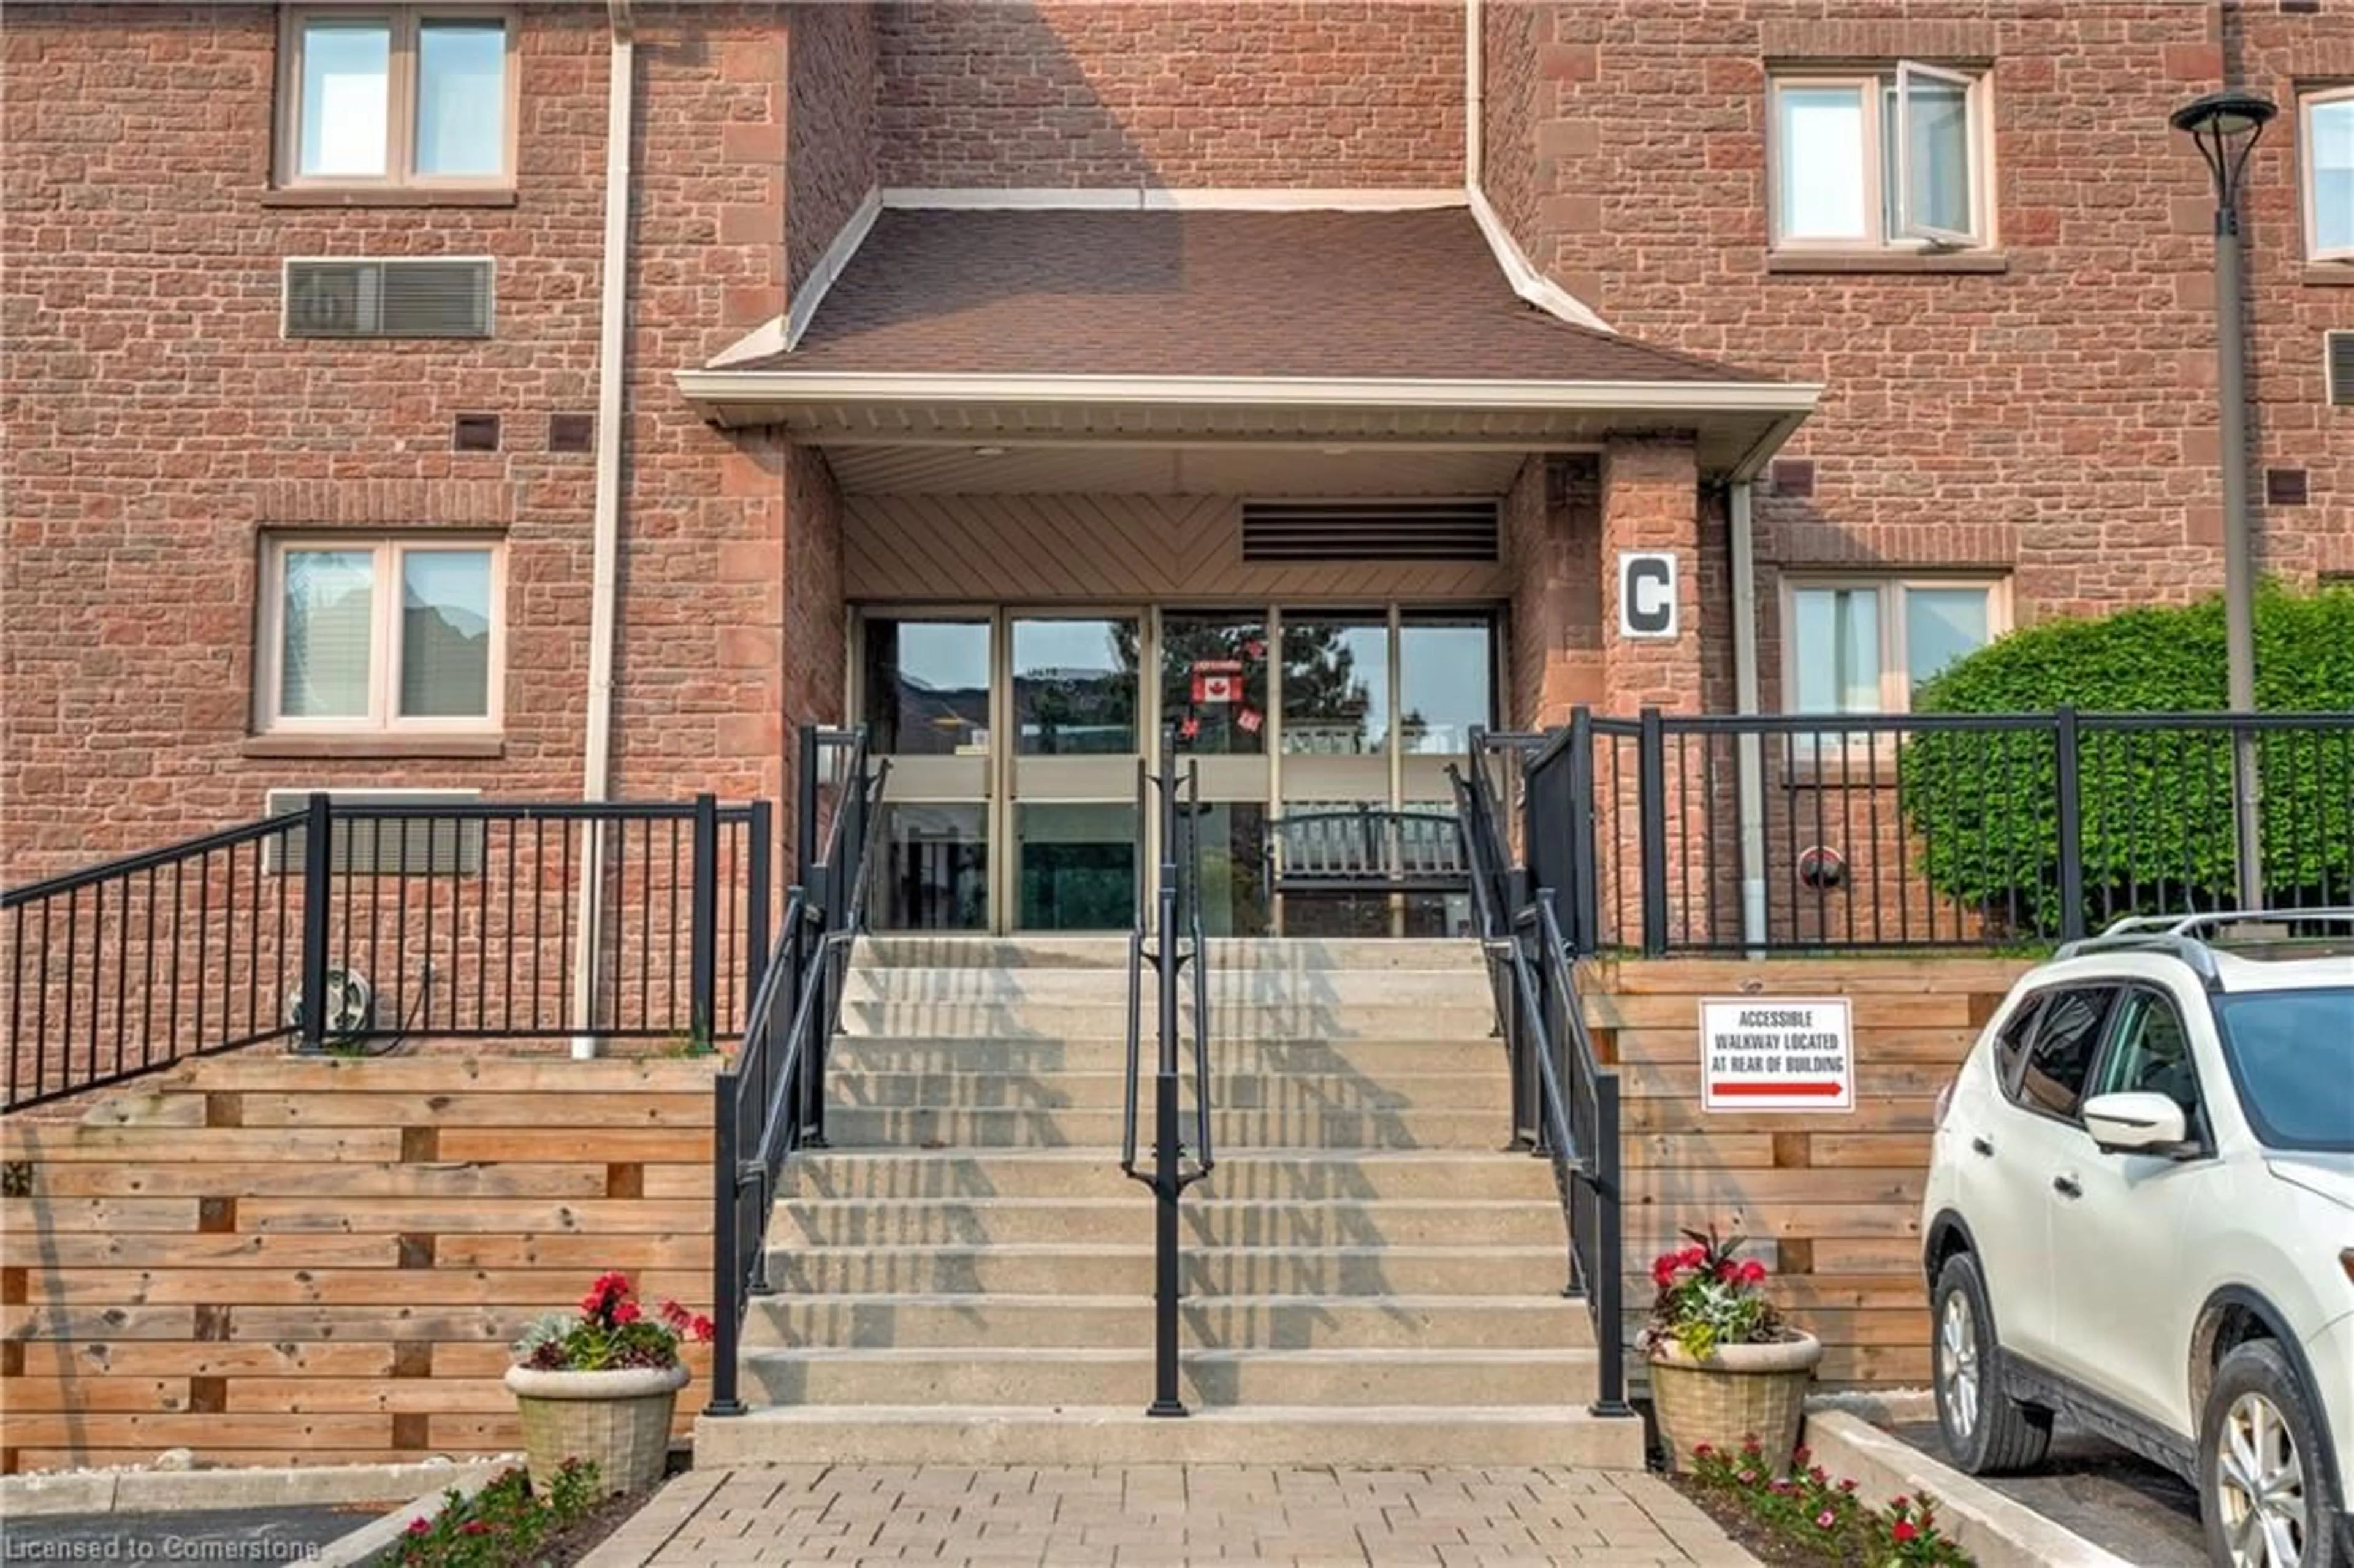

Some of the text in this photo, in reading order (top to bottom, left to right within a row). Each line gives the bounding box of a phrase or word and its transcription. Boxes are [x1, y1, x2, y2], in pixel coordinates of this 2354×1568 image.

[1626, 558, 1670, 633] C
[1739, 1011, 1812, 1027] ACCESSIBLE
[1715, 1033, 1838, 1050] WALKWAY LOCATED
[1712, 1056, 1844, 1073] AT REAR OF BUILDING
